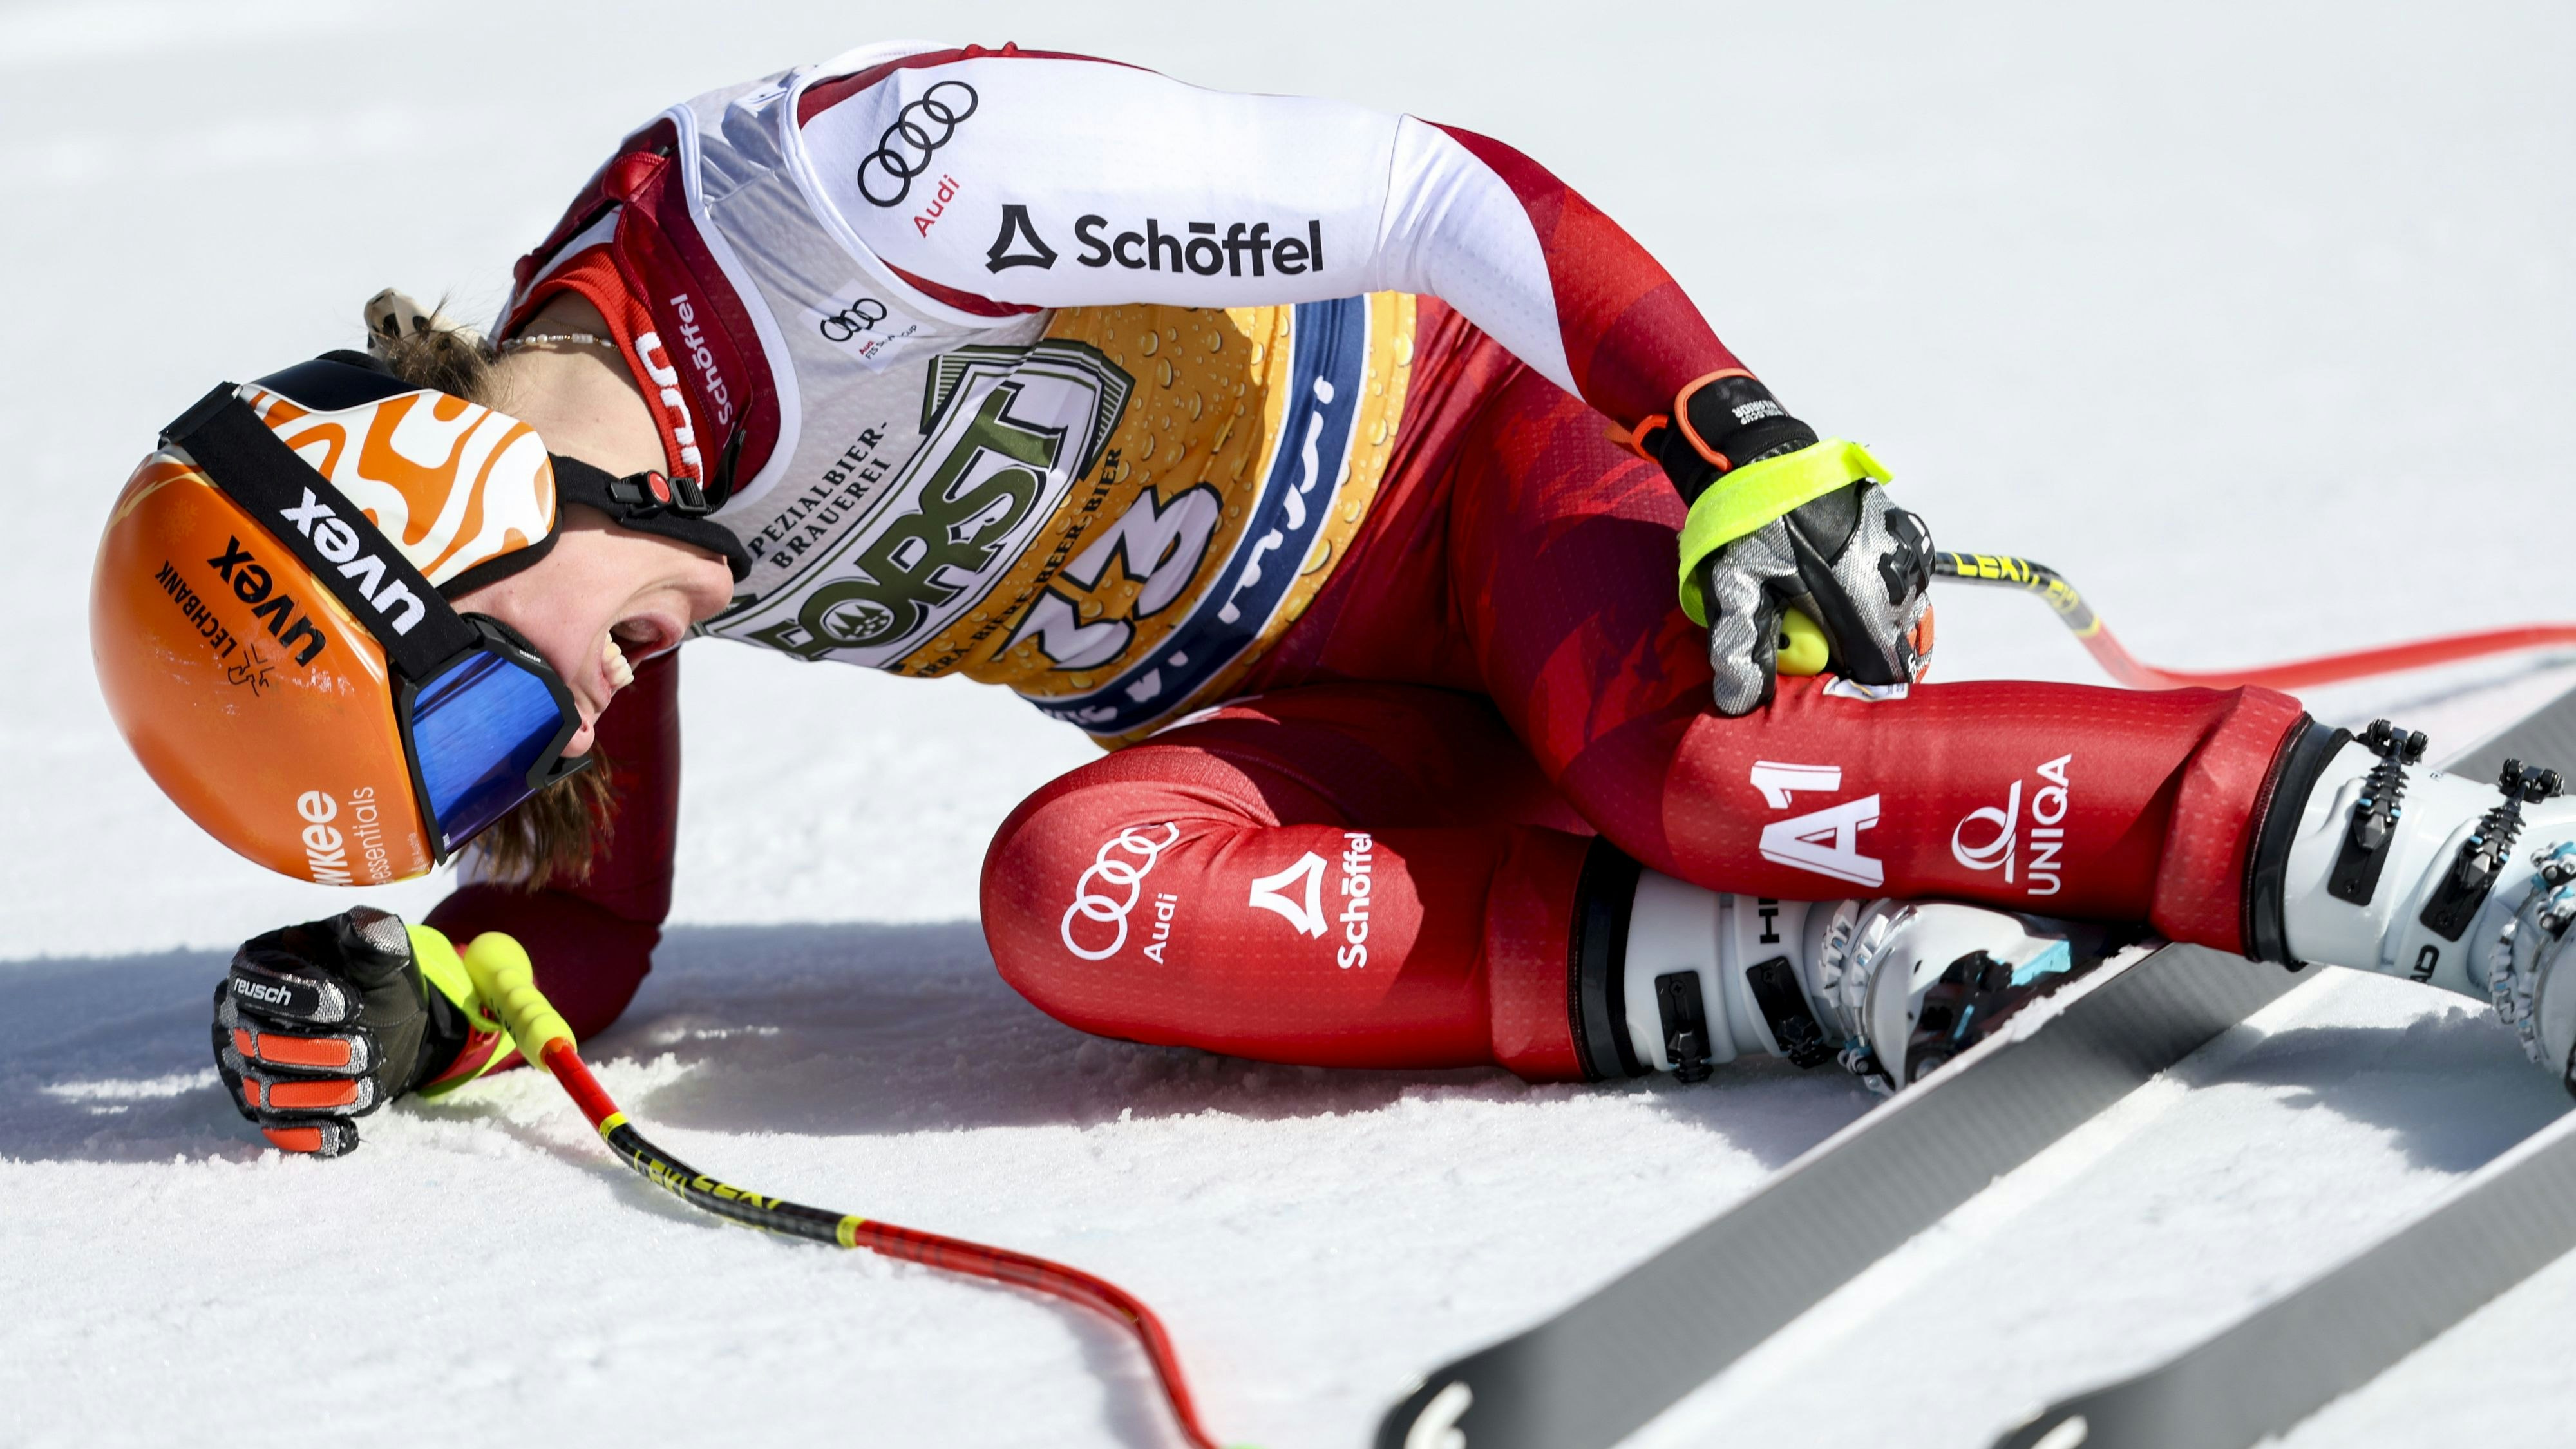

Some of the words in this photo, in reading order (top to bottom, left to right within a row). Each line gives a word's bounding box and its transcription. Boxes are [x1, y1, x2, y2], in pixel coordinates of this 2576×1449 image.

[913, 174, 960, 238] Audi
[744, 380, 1069, 661] FORST
[748, 422, 888, 559] PEZIALBIER-
[770, 457, 891, 569] BRAUEREI
[155, 560, 237, 658] LECHBANK
[207, 535, 327, 668] uvex
[280, 486, 426, 636] uvex
[990, 483, 1224, 671] 33
[297, 790, 354, 886] wkee
[1750, 761, 1884, 888] A1
[2027, 753, 2072, 895] UNIQA
[234, 977, 292, 1006] reusch
[1143, 893, 1177, 965] Audi
